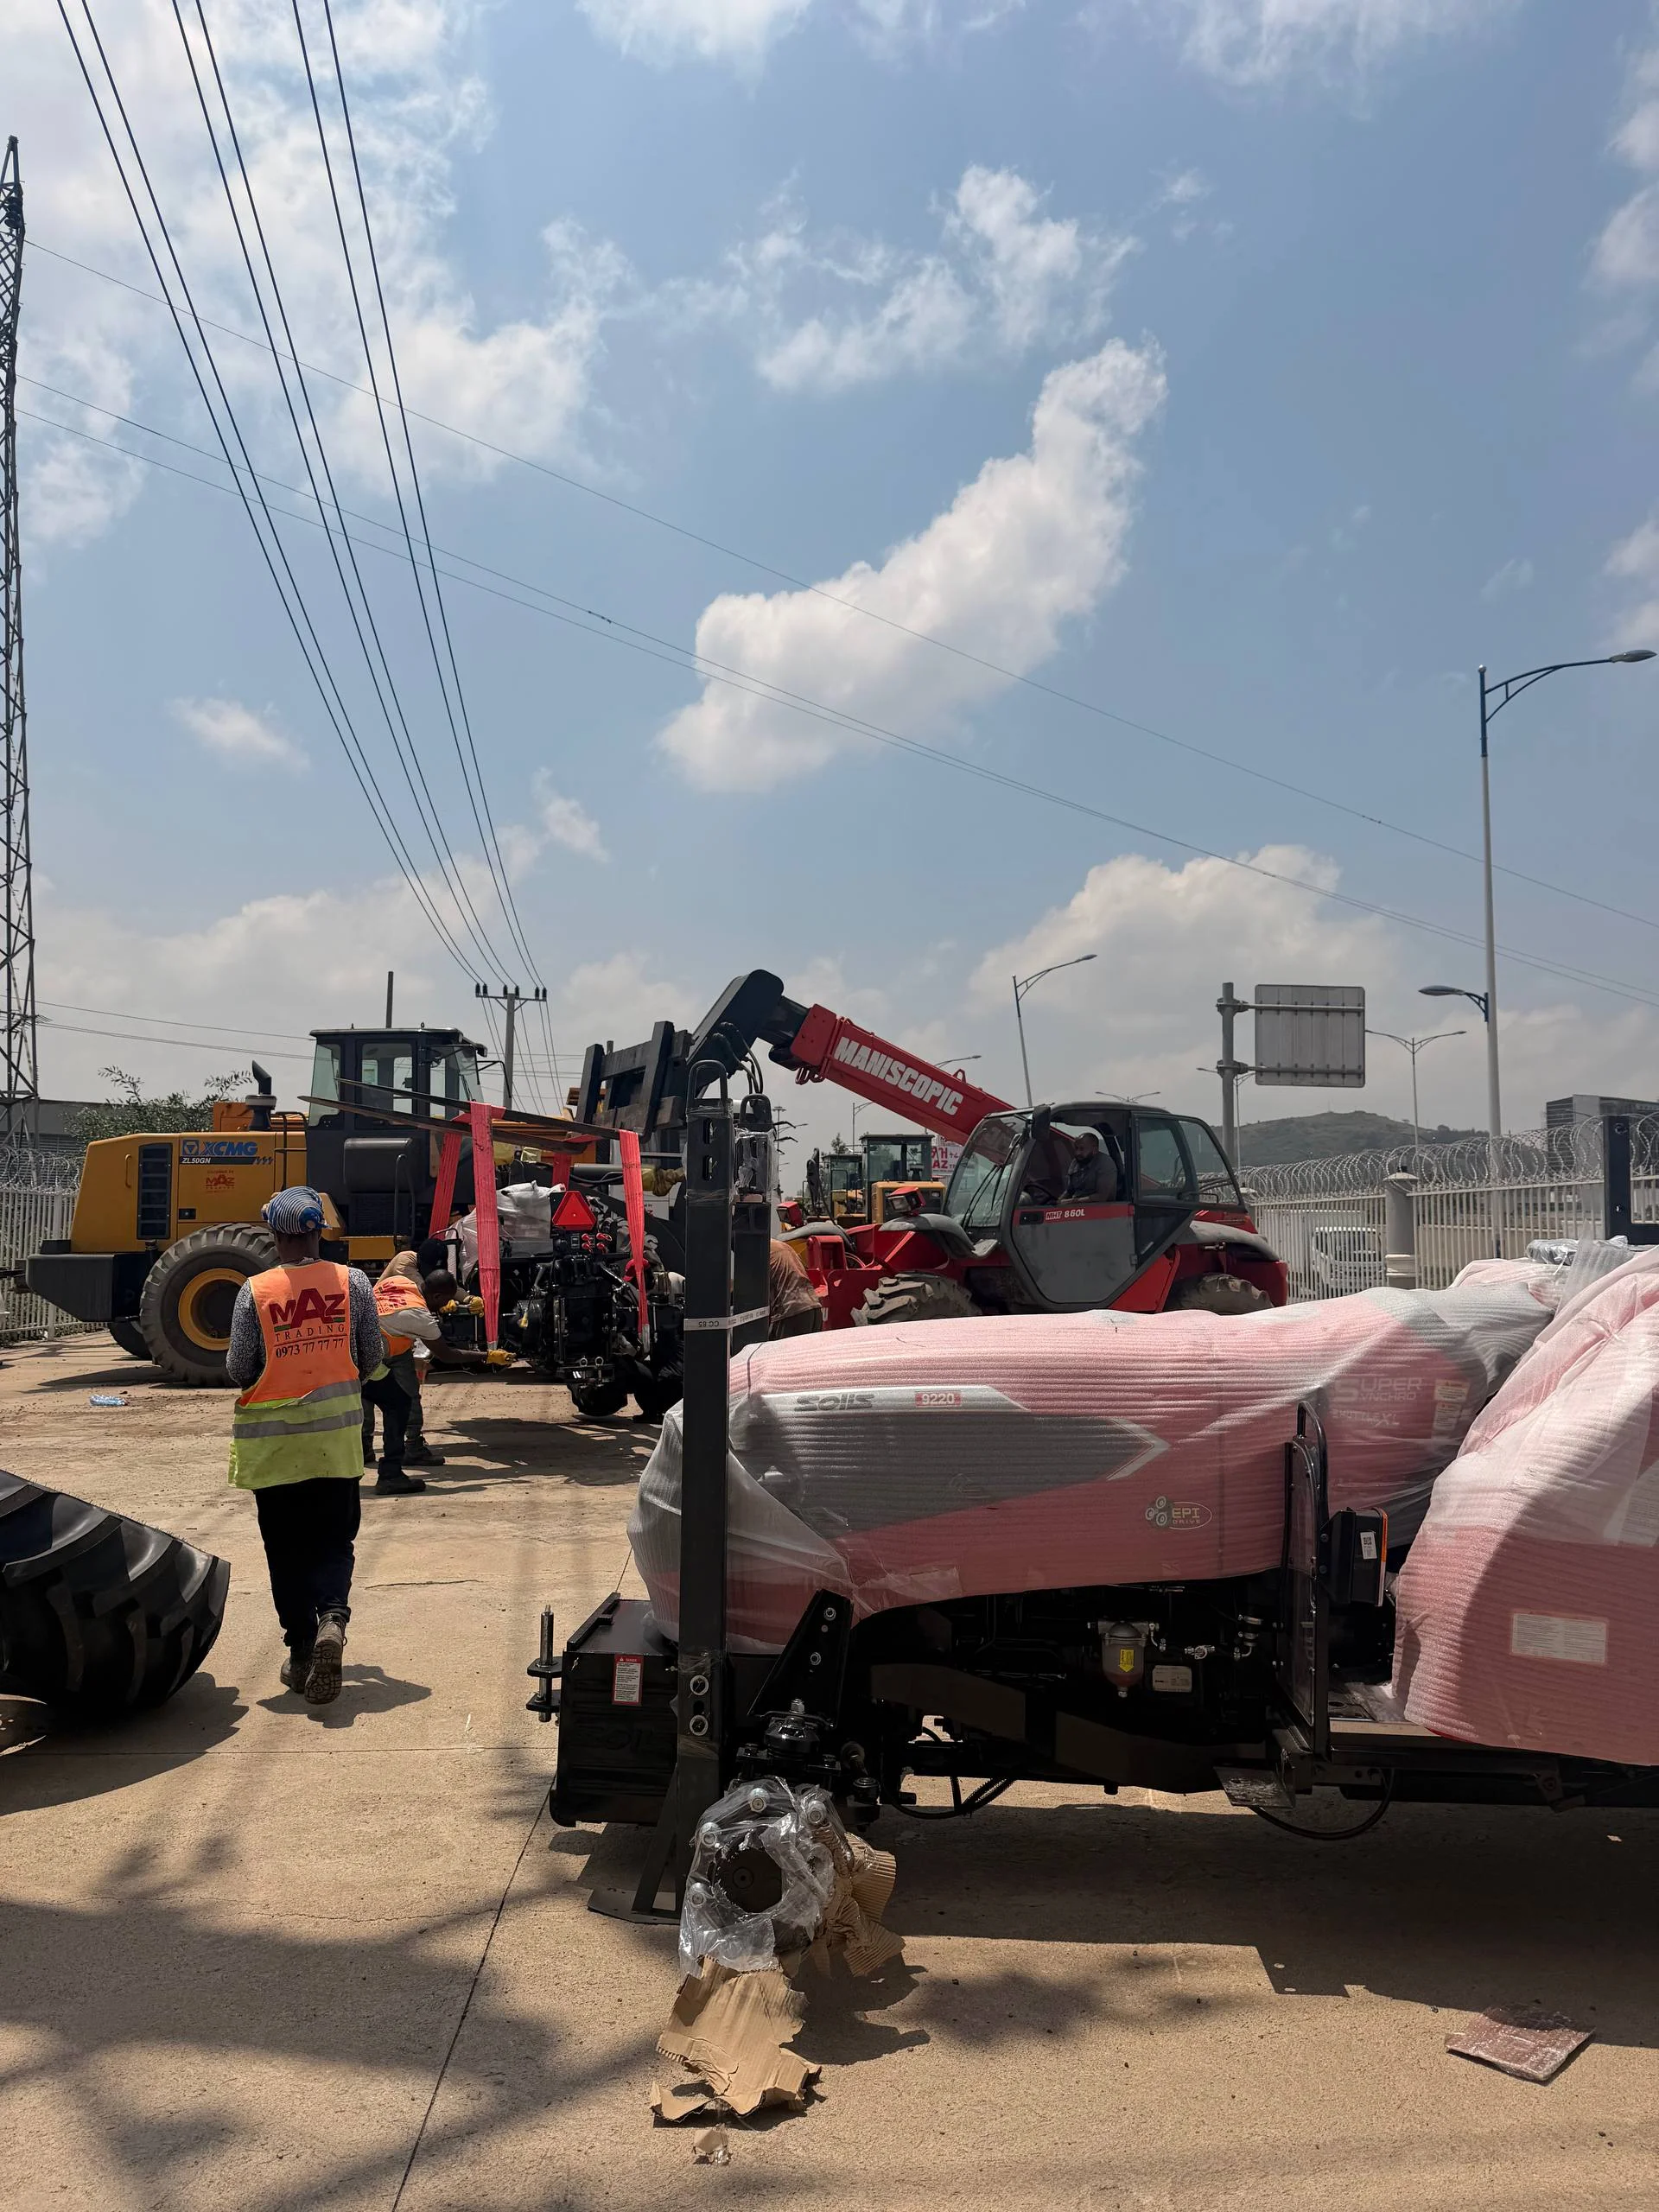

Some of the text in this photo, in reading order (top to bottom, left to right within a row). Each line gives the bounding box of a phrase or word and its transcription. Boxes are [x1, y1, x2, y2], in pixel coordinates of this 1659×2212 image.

[833, 1036, 963, 1116] MANISCOPIC
[200, 1141, 258, 1156] XCMG
[932, 1160, 948, 1169] AZ
[206, 1173, 235, 1186] MAZ
[1064, 1209, 1085, 1218] 860L
[269, 1287, 346, 1330] MAZ
[275, 1325, 345, 1343] TRADING
[276, 1338, 344, 1358] 0973 77 77 77
[1334, 1377, 1423, 1402] SUPER
[921, 1393, 956, 1405] 9220
[1172, 1507, 1200, 1519] EPI
